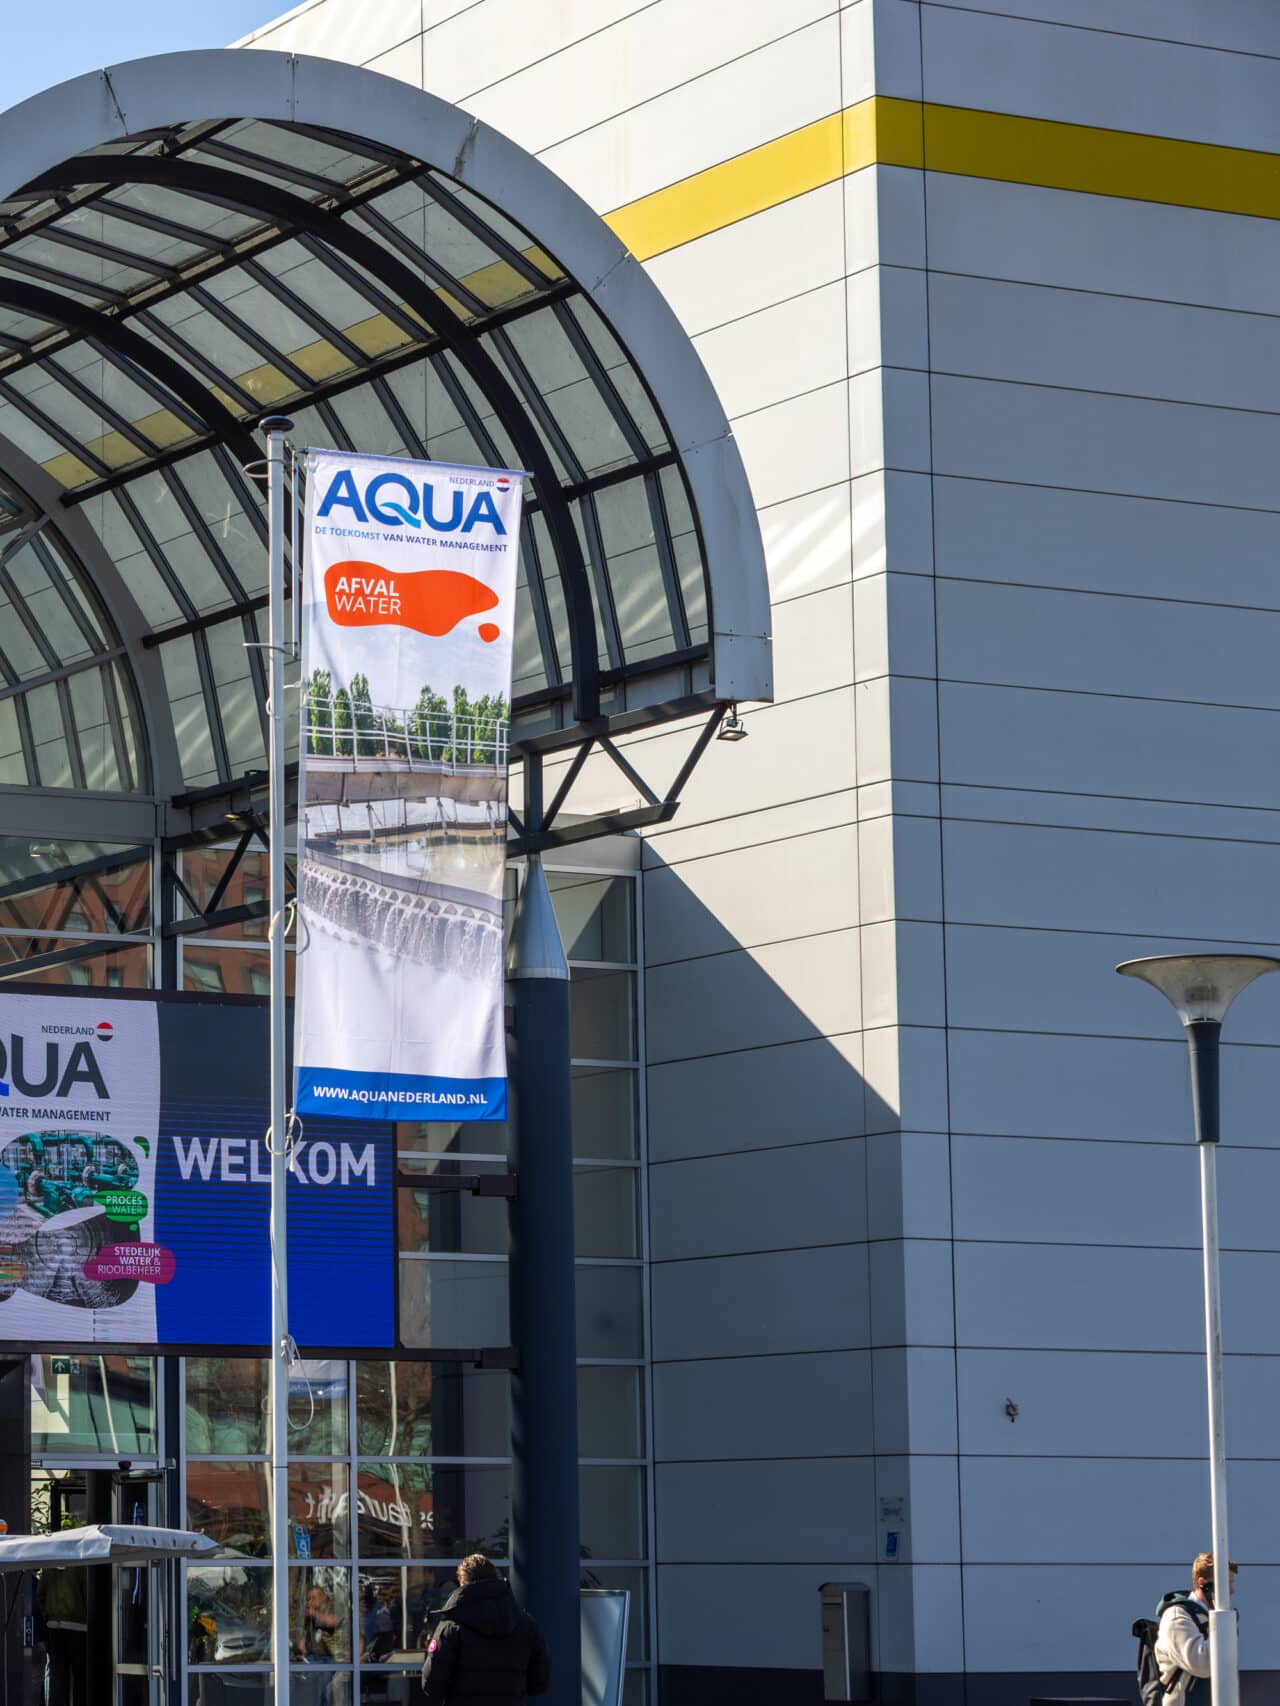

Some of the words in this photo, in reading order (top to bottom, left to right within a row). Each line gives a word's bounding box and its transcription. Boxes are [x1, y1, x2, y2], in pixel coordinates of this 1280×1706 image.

[449, 476, 495, 488] NEDERLAND
[316, 469, 507, 536] AQUA
[315, 526, 327, 535] DE
[330, 527, 381, 541] TOEKOMST
[382, 533, 404, 543] VAN
[405, 535, 438, 547] WATER
[439, 540, 509, 553] MANAGEMENT
[335, 576, 400, 597] AFVAL
[334, 594, 402, 615] WATER
[41, 1024, 95, 1036] NEDERLAND
[313, 1085, 488, 1105] WWW.AQUANEDERLAND.NL
[31, 1108, 111, 1121] MANAGEMENT
[172, 1135, 376, 1187] WELKOM
[106, 1195, 143, 1205] PROCES
[112, 1205, 143, 1215] WATER
[114, 1246, 161, 1258] STEDELIJK
[119, 1257, 152, 1266] WATER
[153, 1257, 161, 1266] &
[97, 1265, 161, 1276] RIOOLBEHEER
